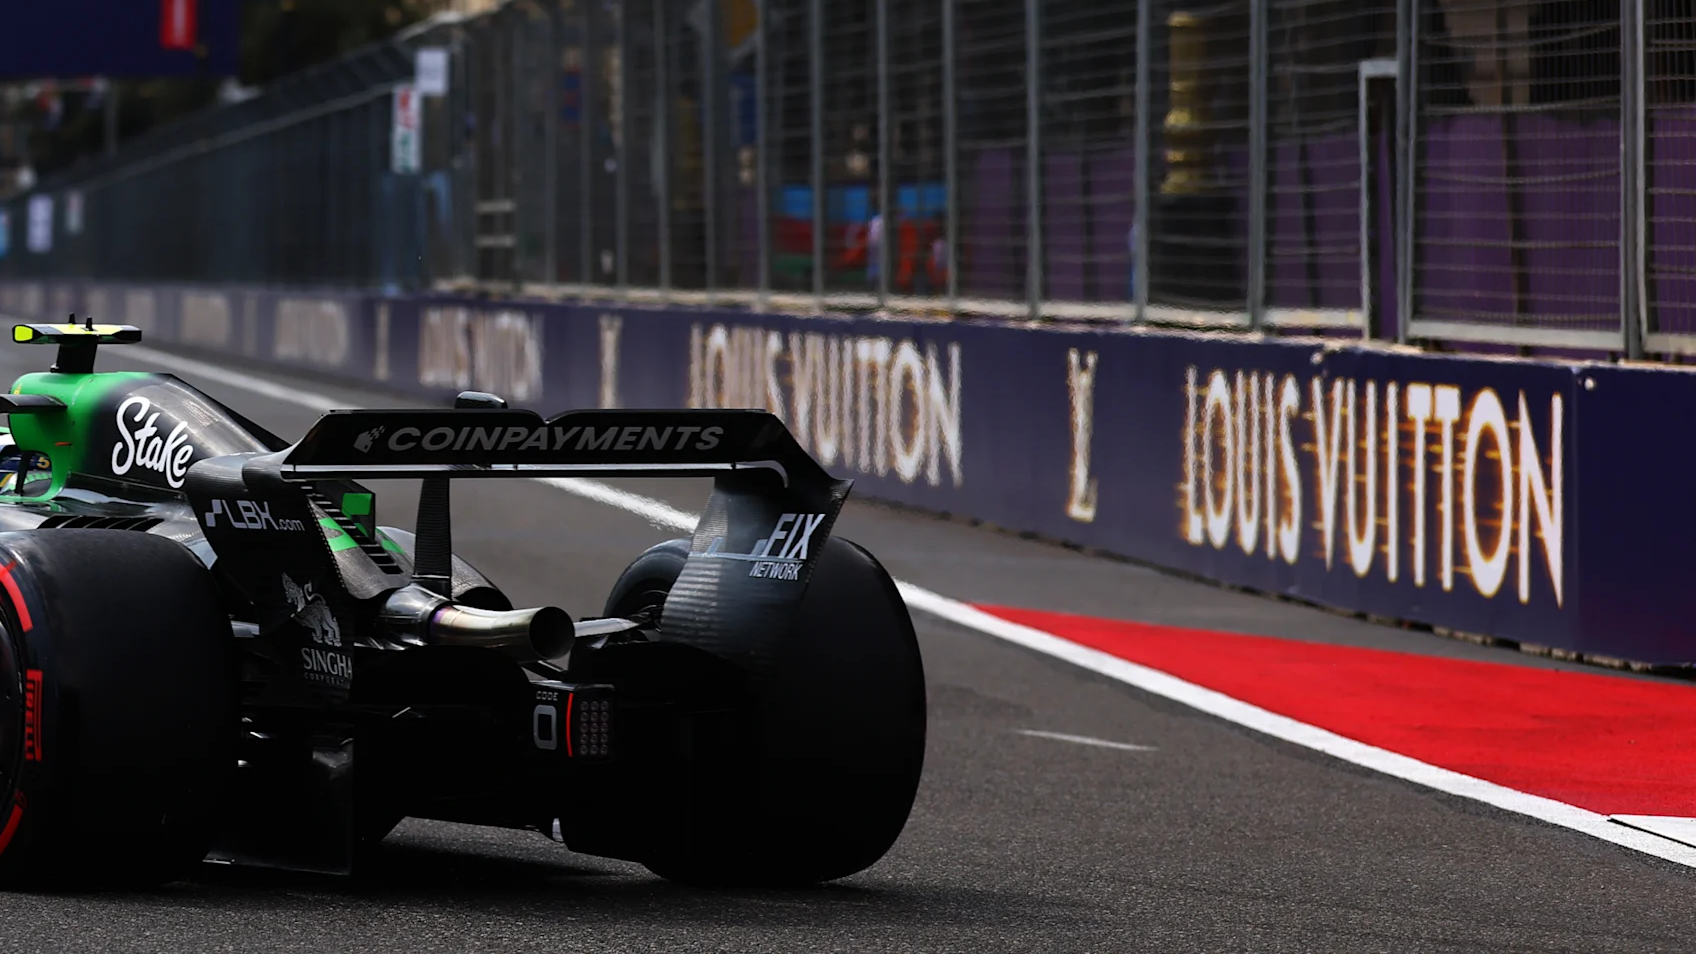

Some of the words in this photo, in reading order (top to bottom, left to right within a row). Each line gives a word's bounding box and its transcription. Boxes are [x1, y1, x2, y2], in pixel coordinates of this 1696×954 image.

[788, 331, 964, 489] VUITTON
[112, 396, 194, 489] Stake
[386, 425, 725, 452] COINPAYMENTS
[1182, 364, 1302, 565] LOUIS
[1311, 376, 1564, 607] VUITTON
[762, 513, 826, 560] FIX
[749, 560, 804, 581] NETWORK
[300, 646, 353, 680] SINGHA
[535, 690, 560, 701] CODE
